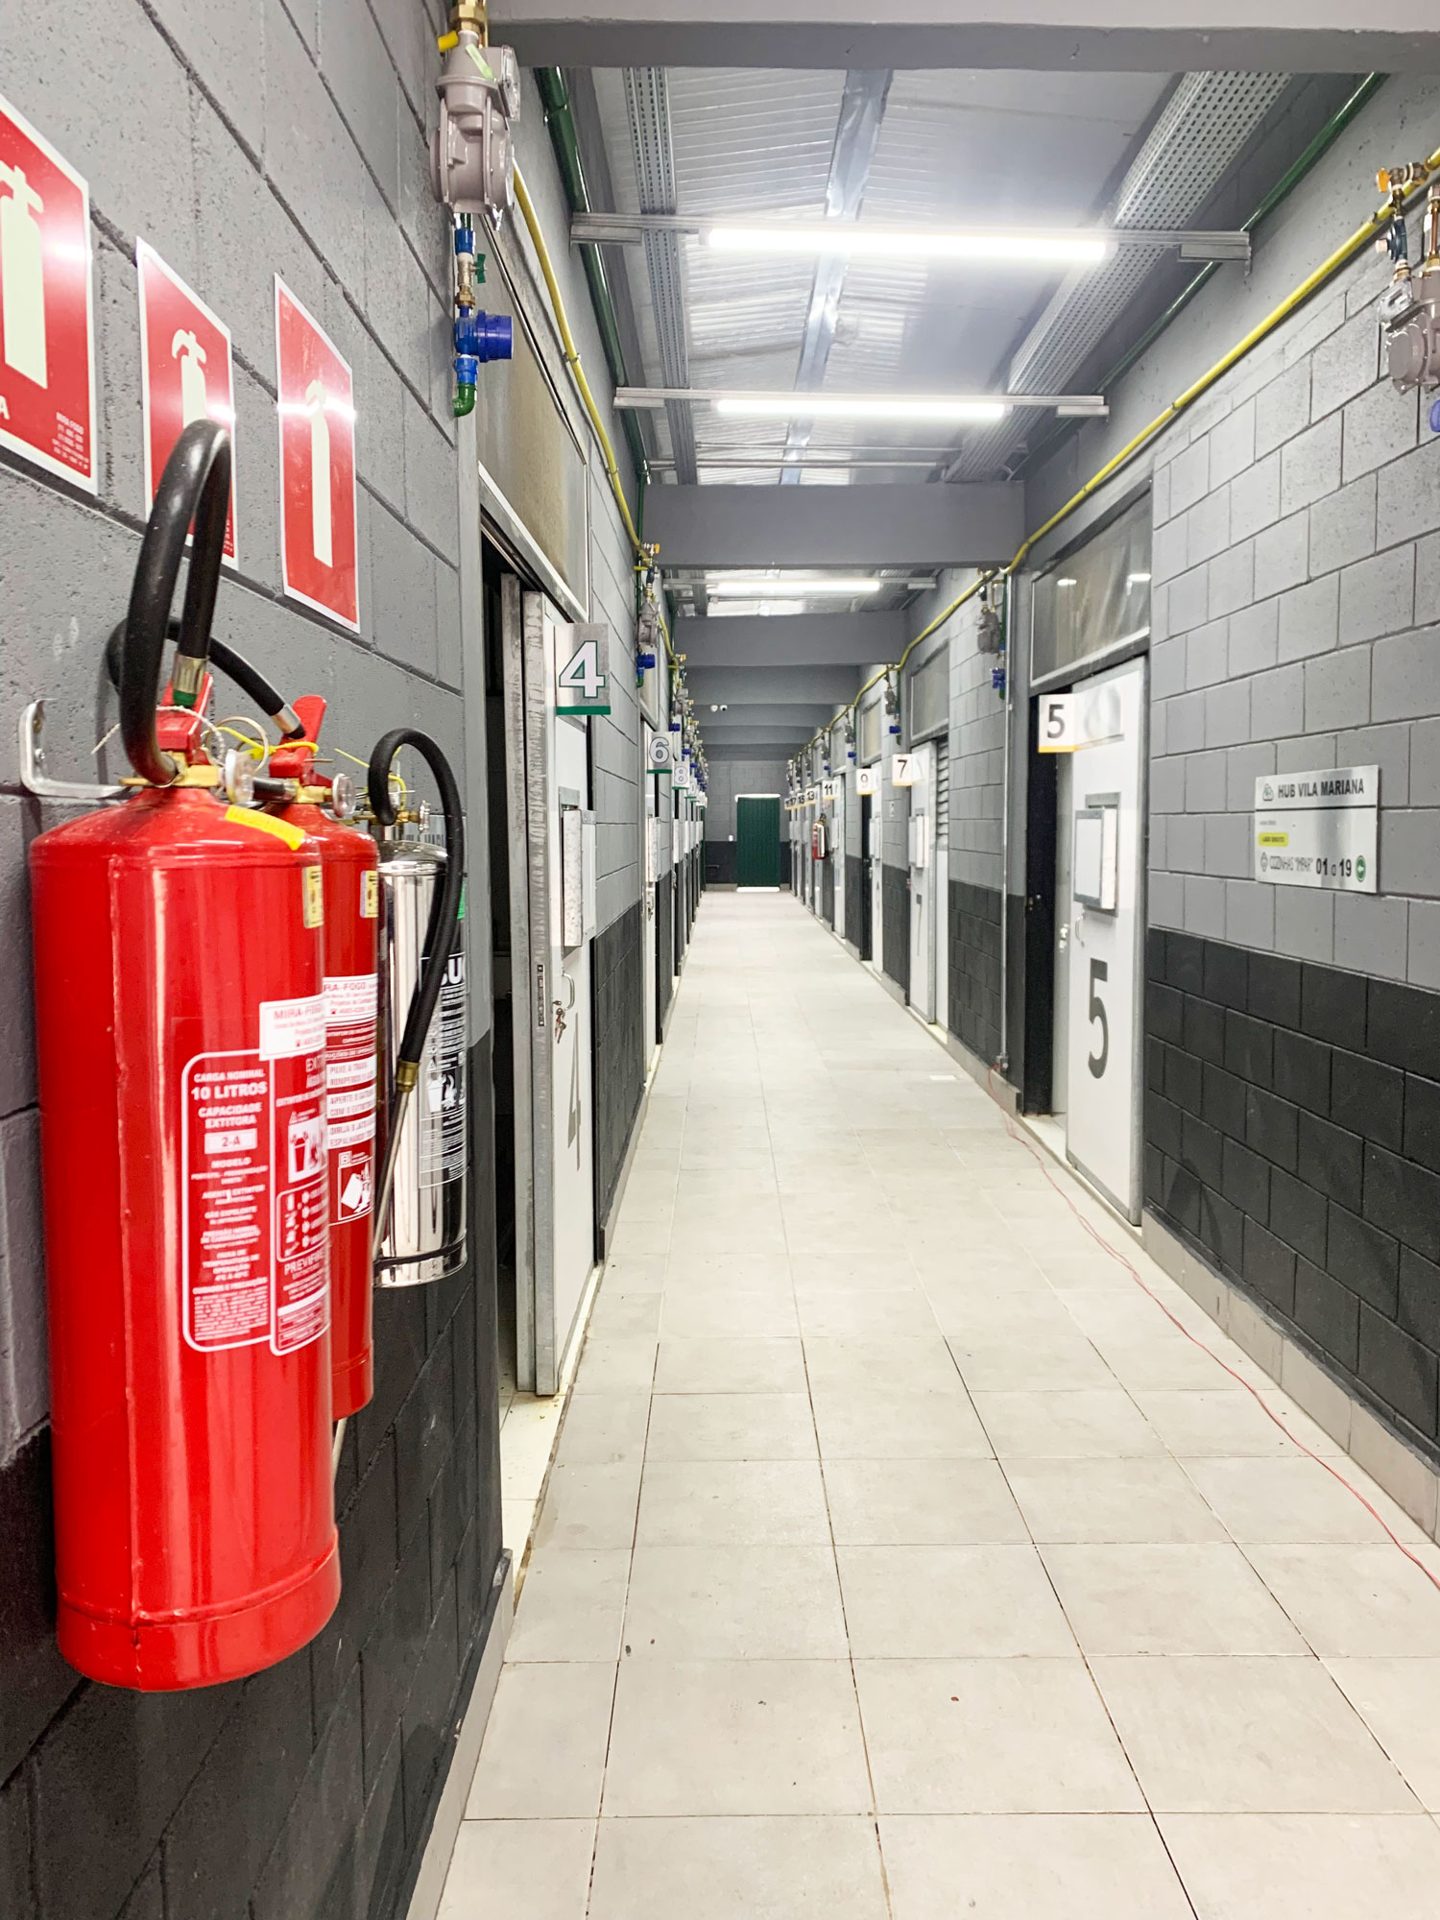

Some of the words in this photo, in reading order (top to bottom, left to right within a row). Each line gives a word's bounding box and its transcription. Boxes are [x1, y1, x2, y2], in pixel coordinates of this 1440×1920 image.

[559, 640, 605, 698] 4
[1047, 704, 1065, 739] 5
[649, 737, 669, 763] 6
[674, 766, 688, 784] 8
[897, 759, 908, 779] 7
[807, 791, 815, 801] 13
[824, 784, 833, 795] 11
[1278, 783, 1296, 798] HUB
[1298, 781, 1318, 798] VILA
[1321, 778, 1364, 796] MARIANA
[1316, 857, 1328, 876] 01
[1339, 858, 1352, 877] 19
[1088, 958, 1109, 1079] 5
[191, 1086, 211, 1101] 10
[214, 1081, 268, 1099] LITROS
[198, 1102, 262, 1118] CAPACIDADE
[221, 1136, 241, 1147] 2-A
